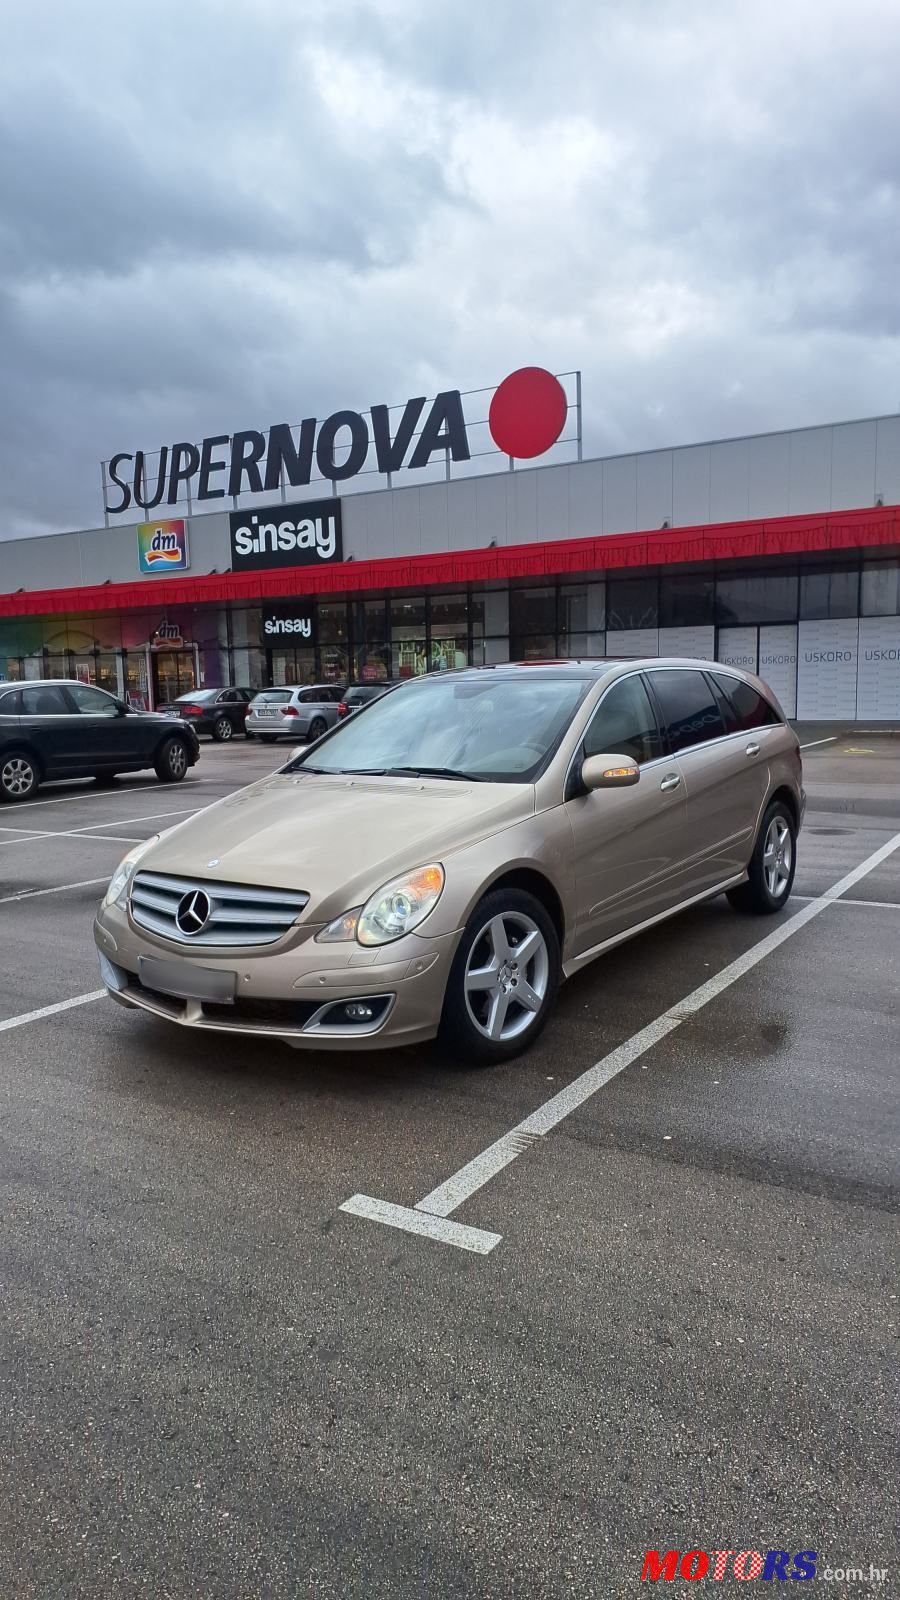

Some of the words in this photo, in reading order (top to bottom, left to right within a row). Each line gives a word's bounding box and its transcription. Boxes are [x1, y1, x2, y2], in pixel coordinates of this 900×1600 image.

[106, 391, 470, 513] SUPERNOVA
[152, 530, 176, 550] dm
[235, 515, 335, 559] sinsay
[159, 622, 178, 638] dm
[264, 615, 311, 637] sinsay
[720, 656, 754, 665] USKORO
[761, 655, 796, 664] USKORO
[804, 651, 852, 663] USKORO
[864, 649, 900, 661] USKO
